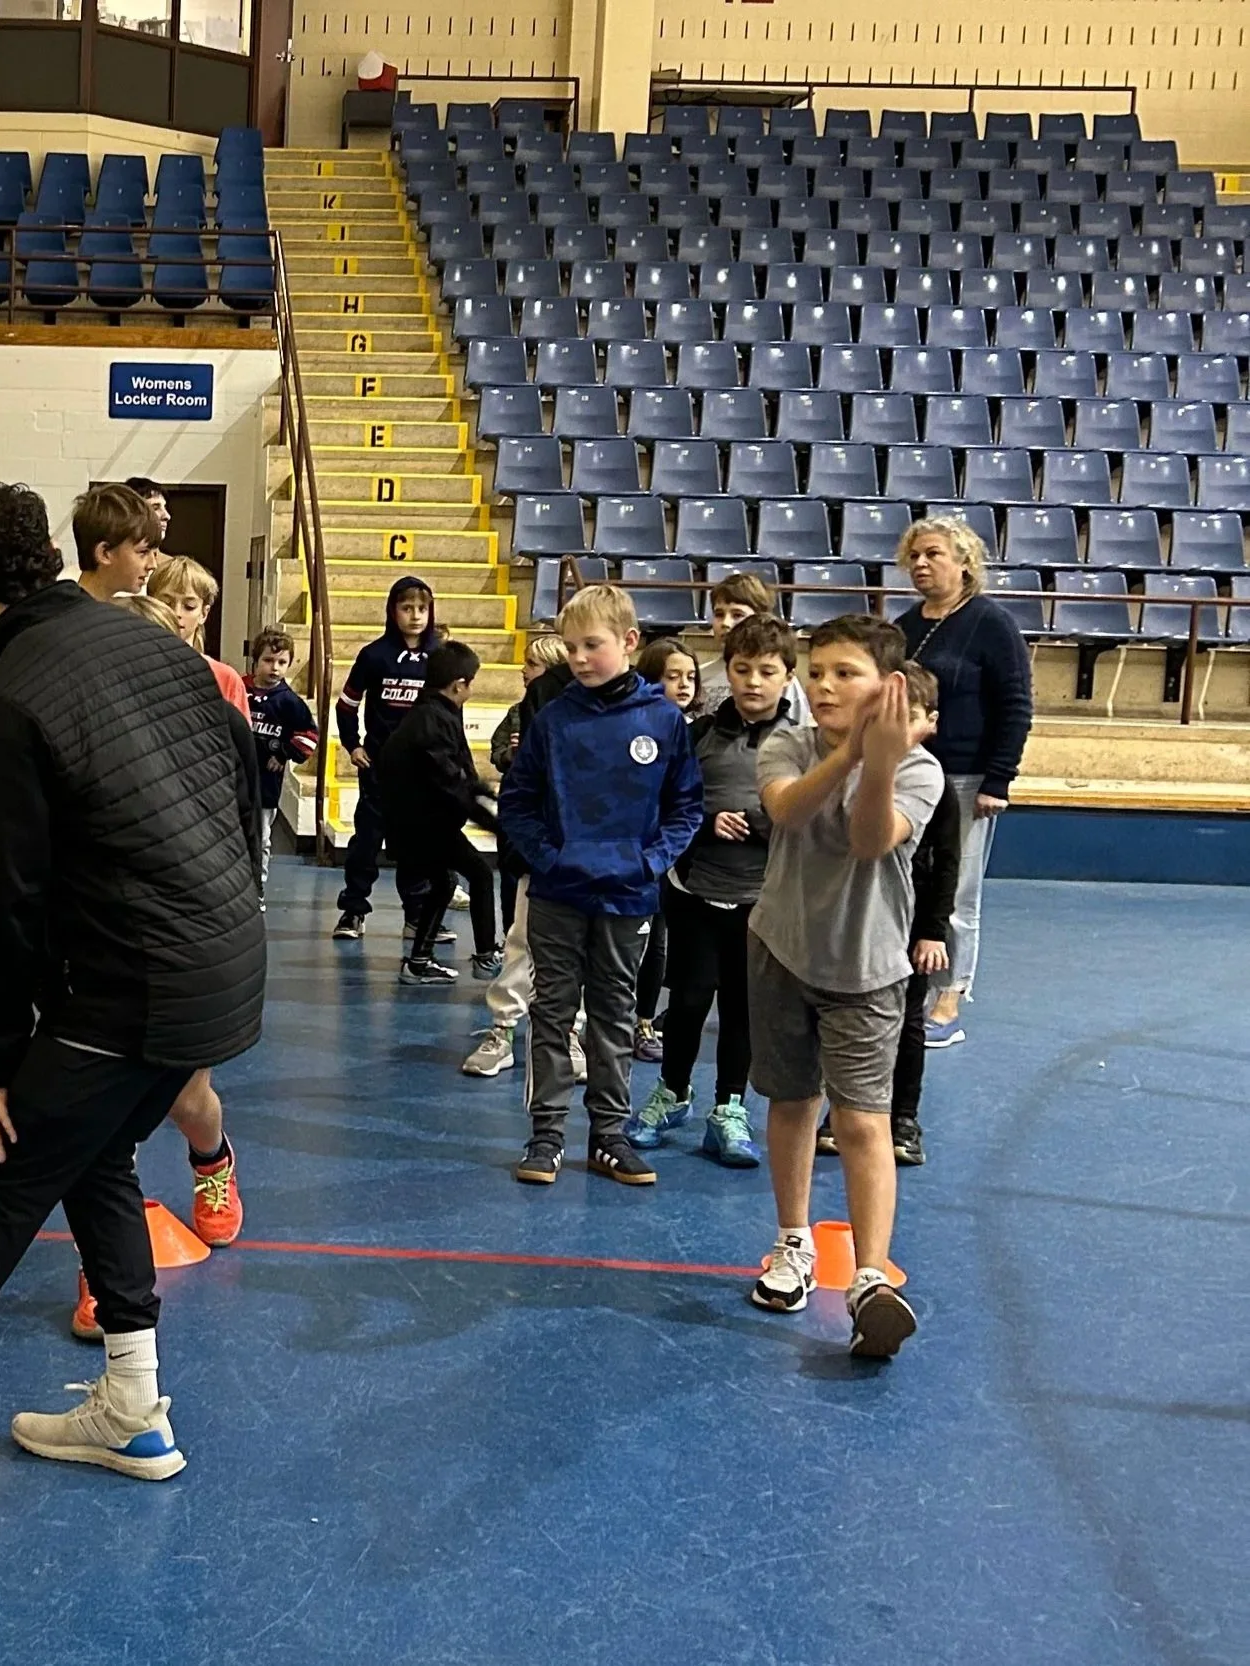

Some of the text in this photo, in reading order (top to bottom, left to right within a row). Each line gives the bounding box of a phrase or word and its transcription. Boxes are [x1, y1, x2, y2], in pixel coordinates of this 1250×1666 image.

[343, 296, 359, 314] H
[351, 334, 366, 352] G
[131, 376, 192, 390] Womens
[361, 377, 376, 397] F
[114, 392, 207, 407] Locker Room
[371, 425, 385, 447] E
[377, 478, 394, 502] D
[389, 534, 407, 560] C
